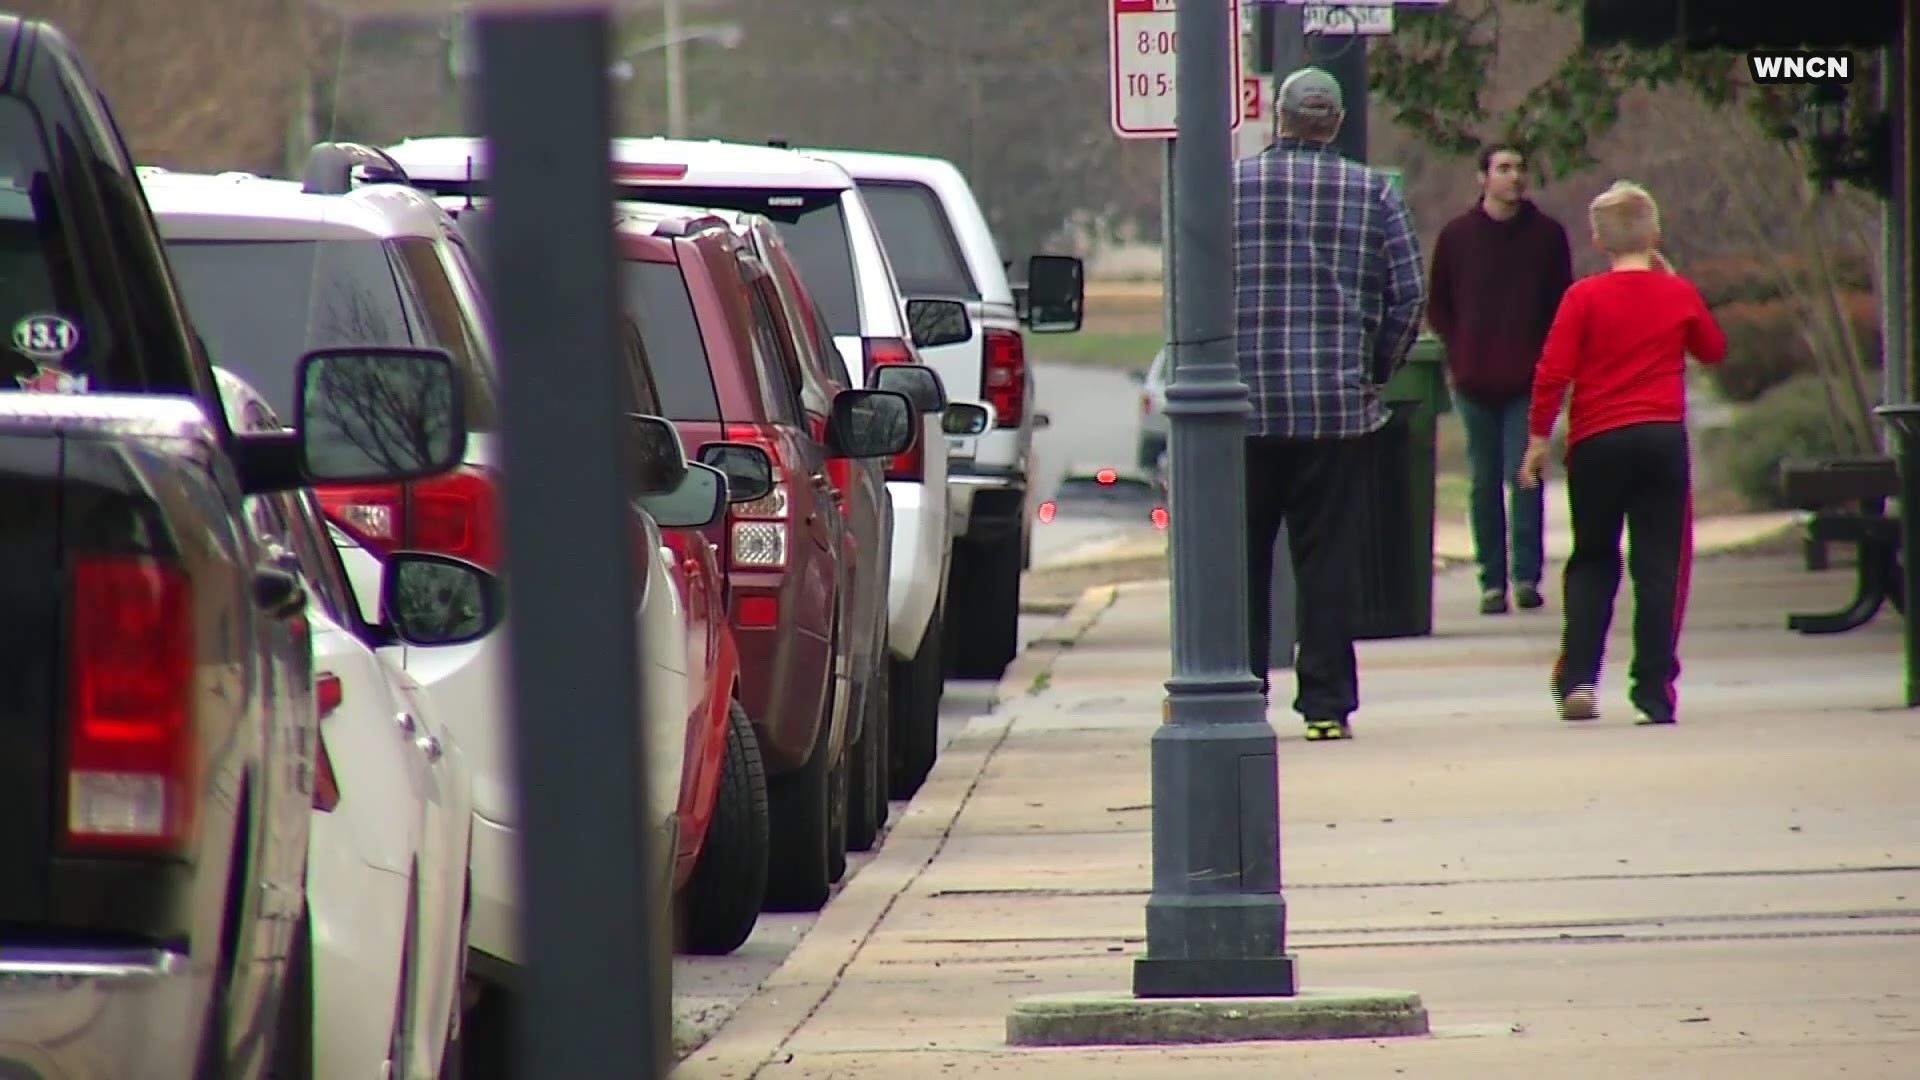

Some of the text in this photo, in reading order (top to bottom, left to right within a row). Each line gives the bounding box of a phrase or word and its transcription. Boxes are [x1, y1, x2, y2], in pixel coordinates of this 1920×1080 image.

[1127, 73, 1173, 96] TO 5:
[16, 322, 70, 349] 13.1
